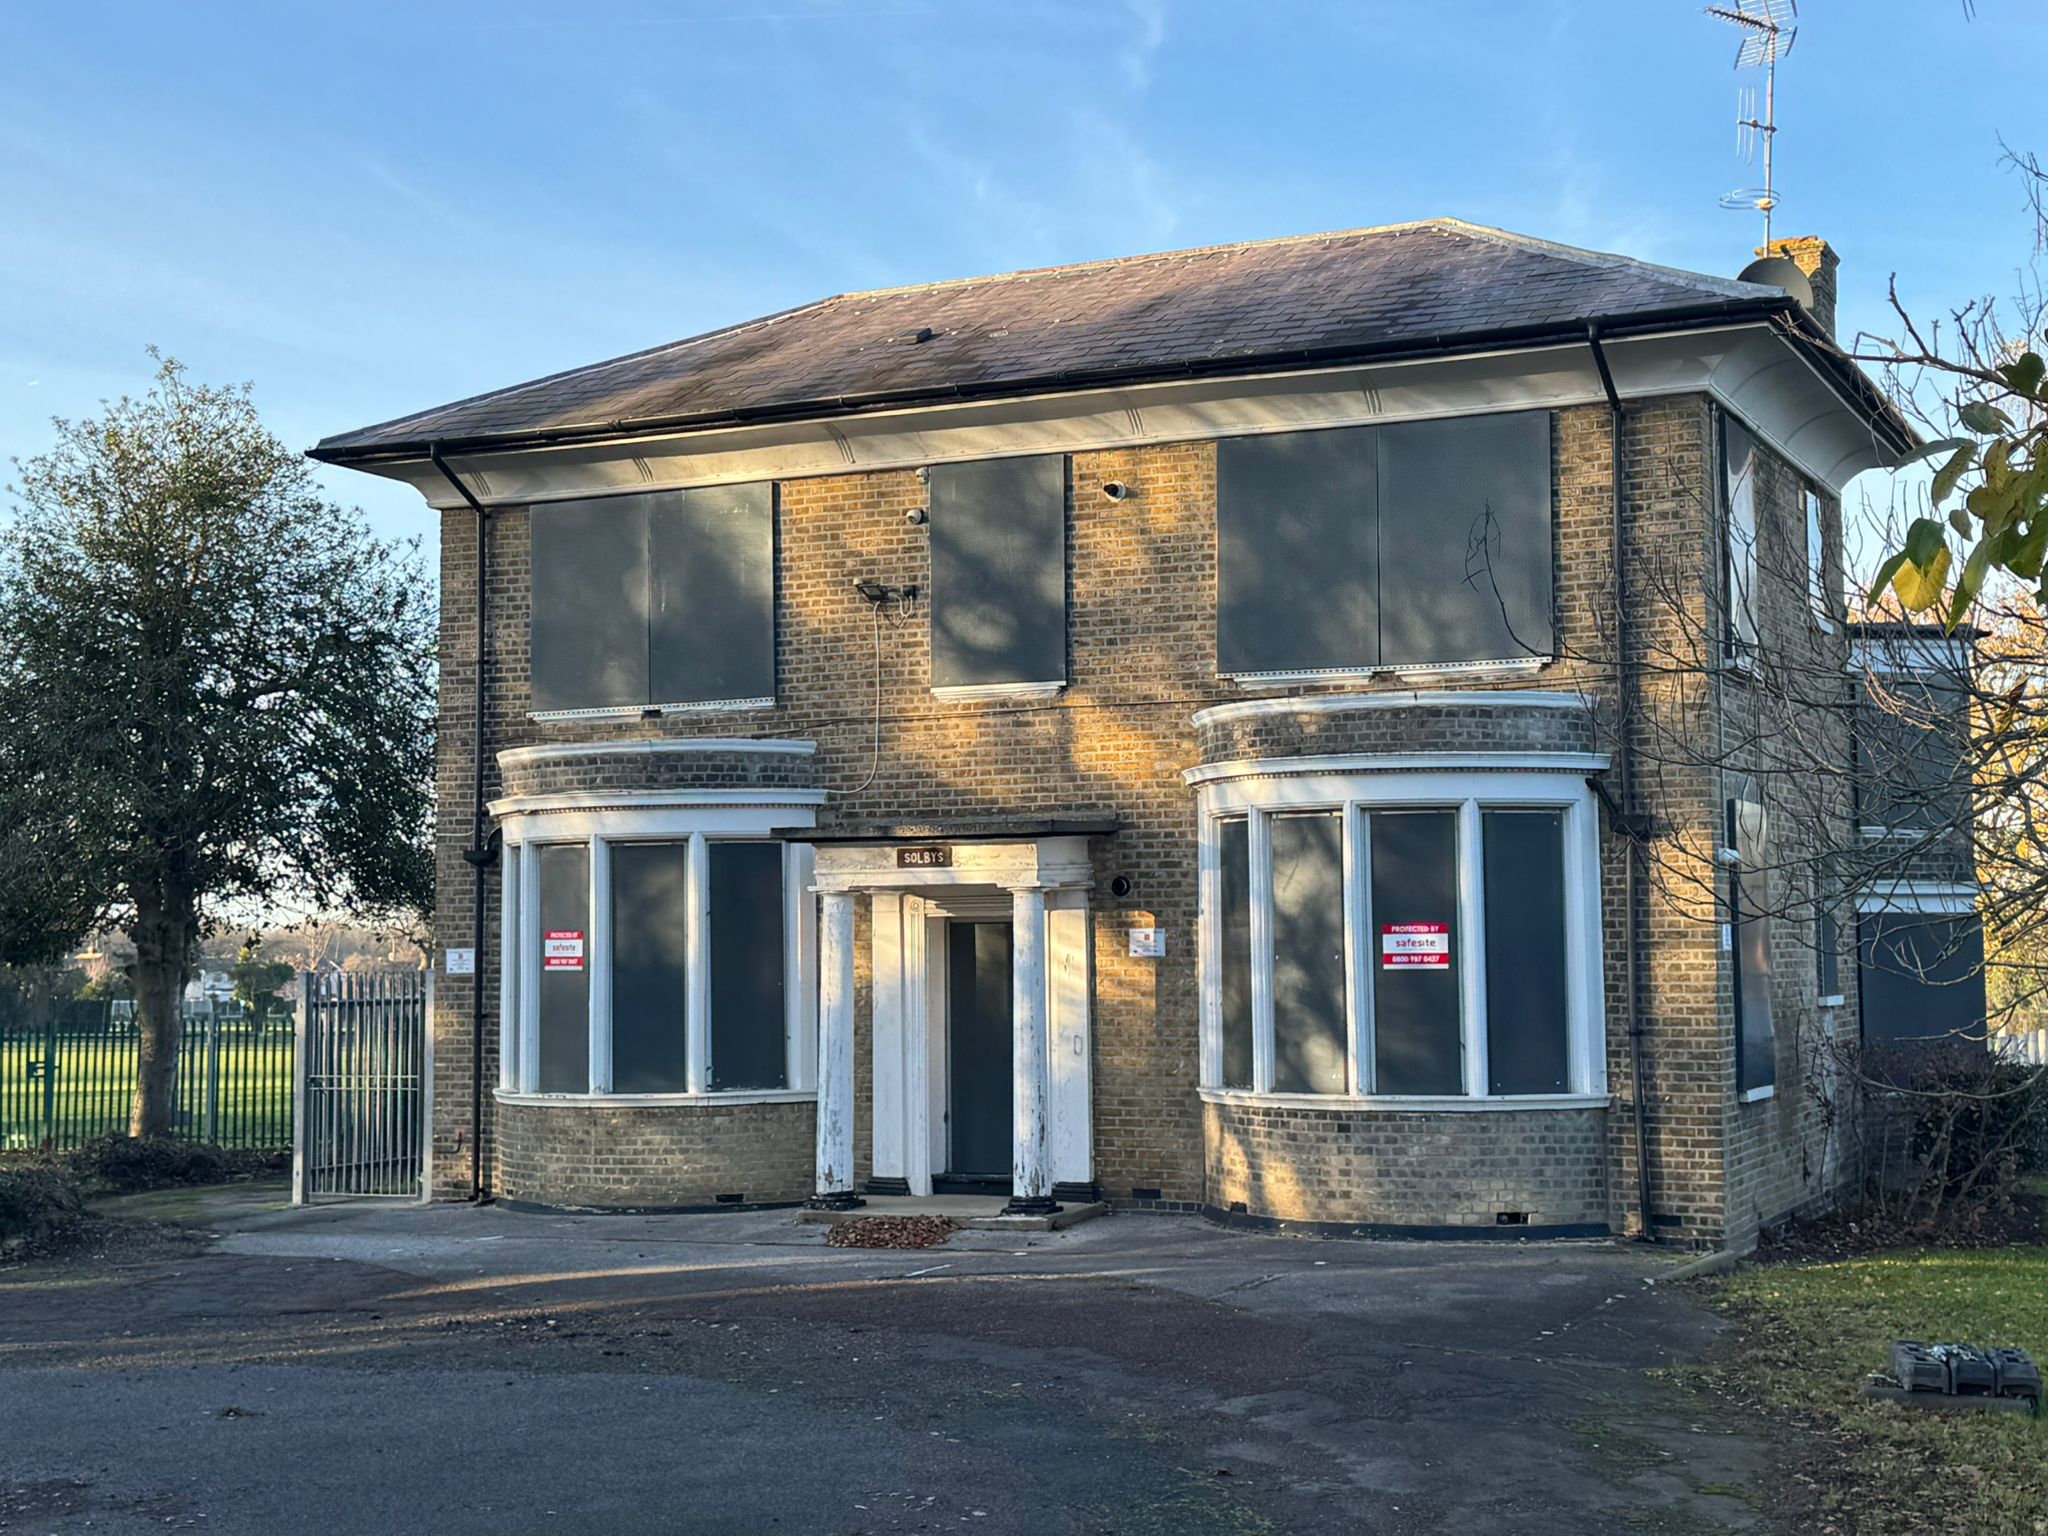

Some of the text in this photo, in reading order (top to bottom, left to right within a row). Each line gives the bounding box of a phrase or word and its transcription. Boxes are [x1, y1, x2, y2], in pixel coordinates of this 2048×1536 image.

[904, 851, 944, 864] SOLBYS
[1391, 925, 1430, 933] PROTECTED
[1395, 938, 1436, 947] safesite
